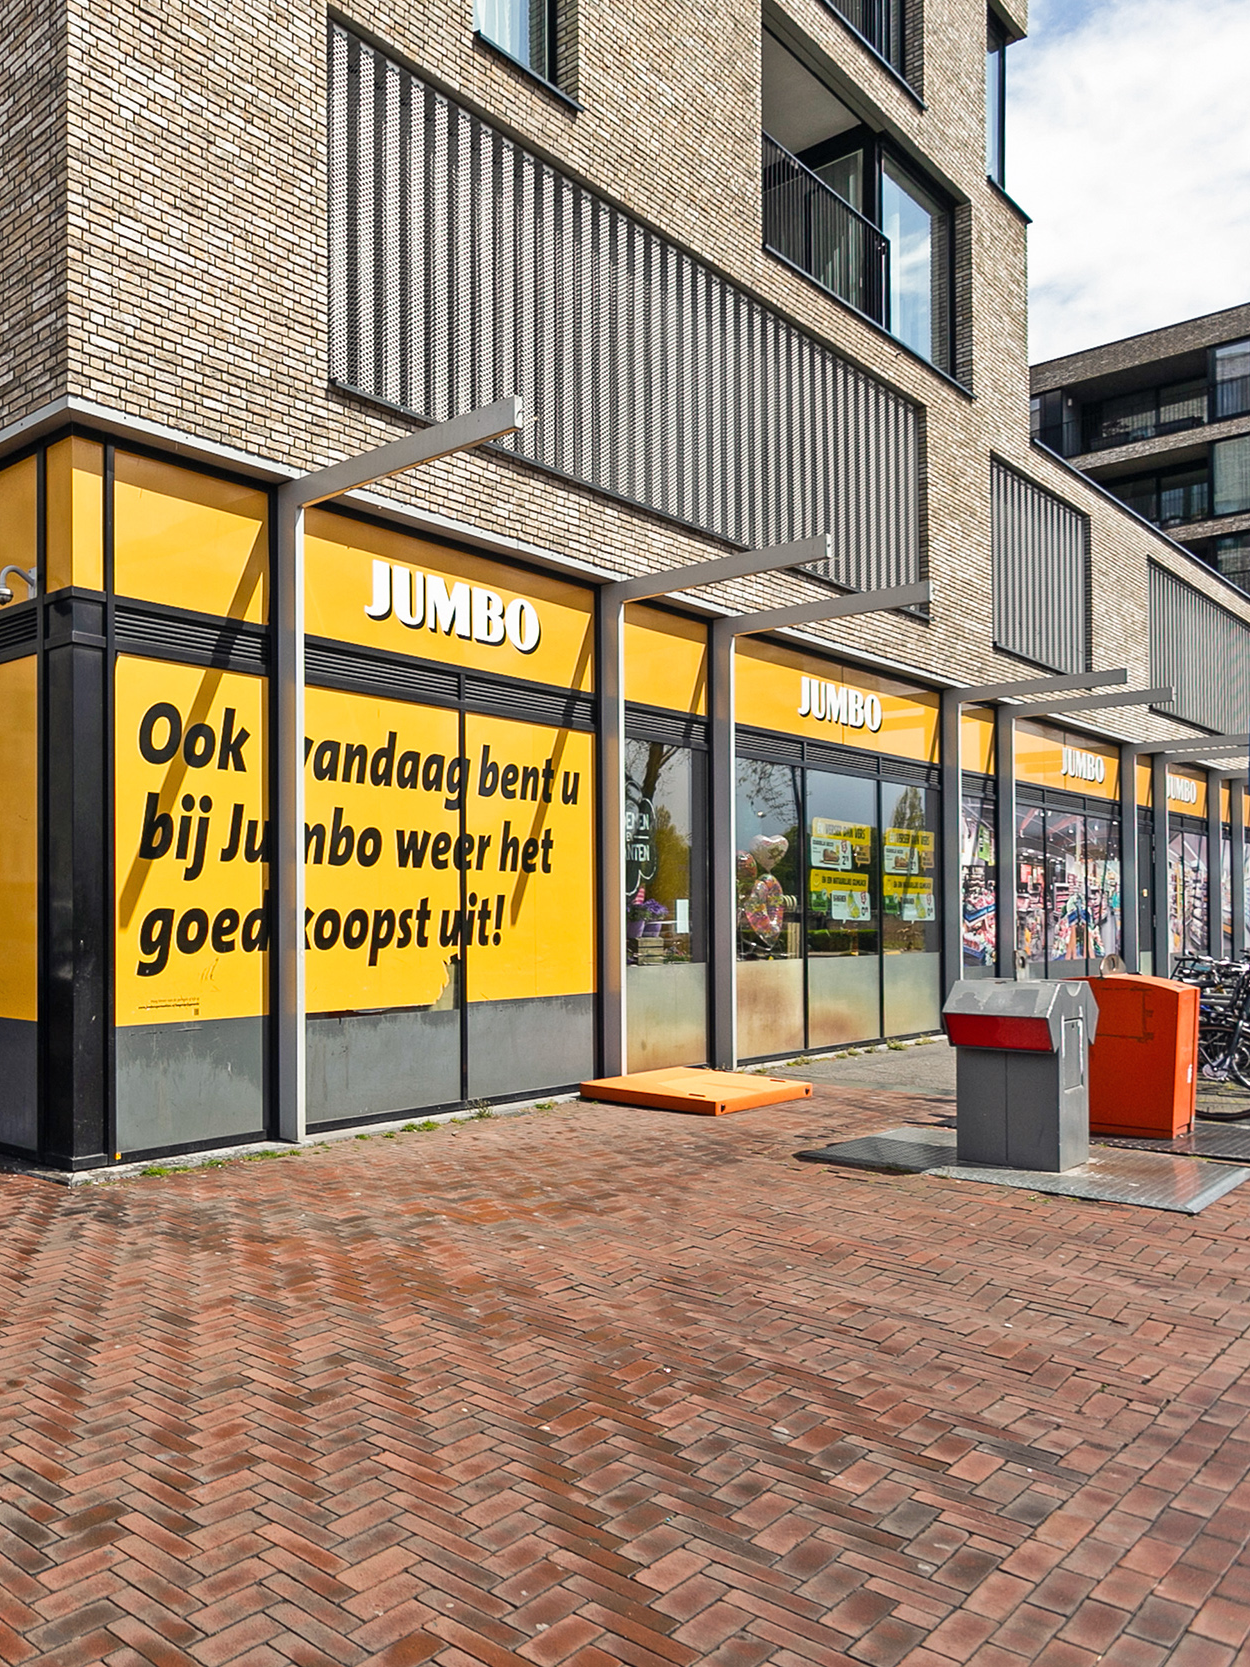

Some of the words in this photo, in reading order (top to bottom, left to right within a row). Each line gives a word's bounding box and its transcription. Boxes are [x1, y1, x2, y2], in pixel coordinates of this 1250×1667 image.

[364, 559, 541, 655] JUMBO
[797, 676, 882, 733] JUMBO
[139, 702, 251, 773] Ook
[478, 745, 555, 803] bent
[561, 771, 580, 805] u
[1060, 747, 1106, 783] JUMBO
[1166, 775, 1198, 804] JUMBO
[138, 792, 213, 881] bij
[396, 829, 492, 871] weer
[498, 820, 554, 873] het
[439, 892, 506, 946] uit!
